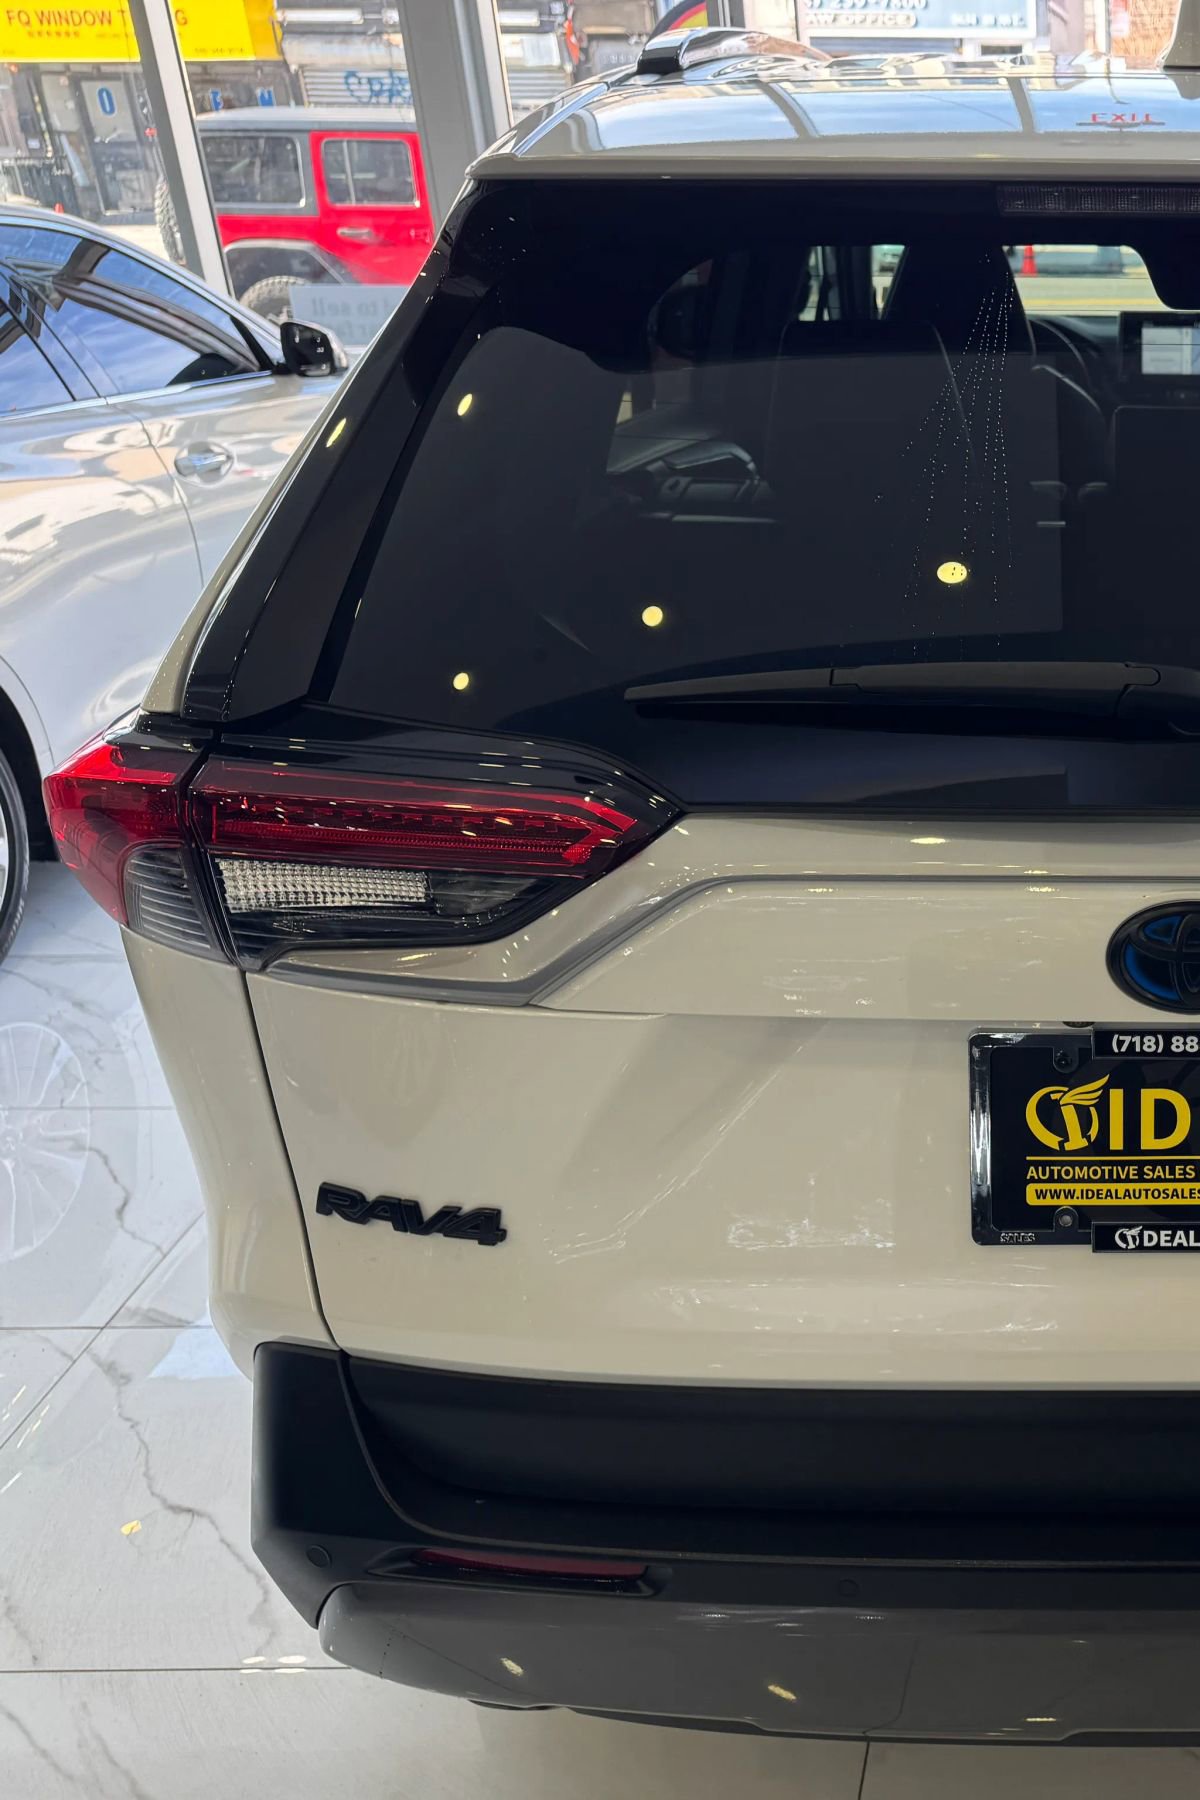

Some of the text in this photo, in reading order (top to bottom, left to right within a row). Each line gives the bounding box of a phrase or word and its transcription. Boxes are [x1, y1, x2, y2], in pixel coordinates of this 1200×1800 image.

[36, 10, 112, 27] WINDOW
[1111, 1033, 1164, 1054] (718)
[1026, 1165, 1139, 1180] AUTOMOTIVE
[1143, 1165, 1196, 1179] SALES
[316, 1177, 507, 1246] RAV4
